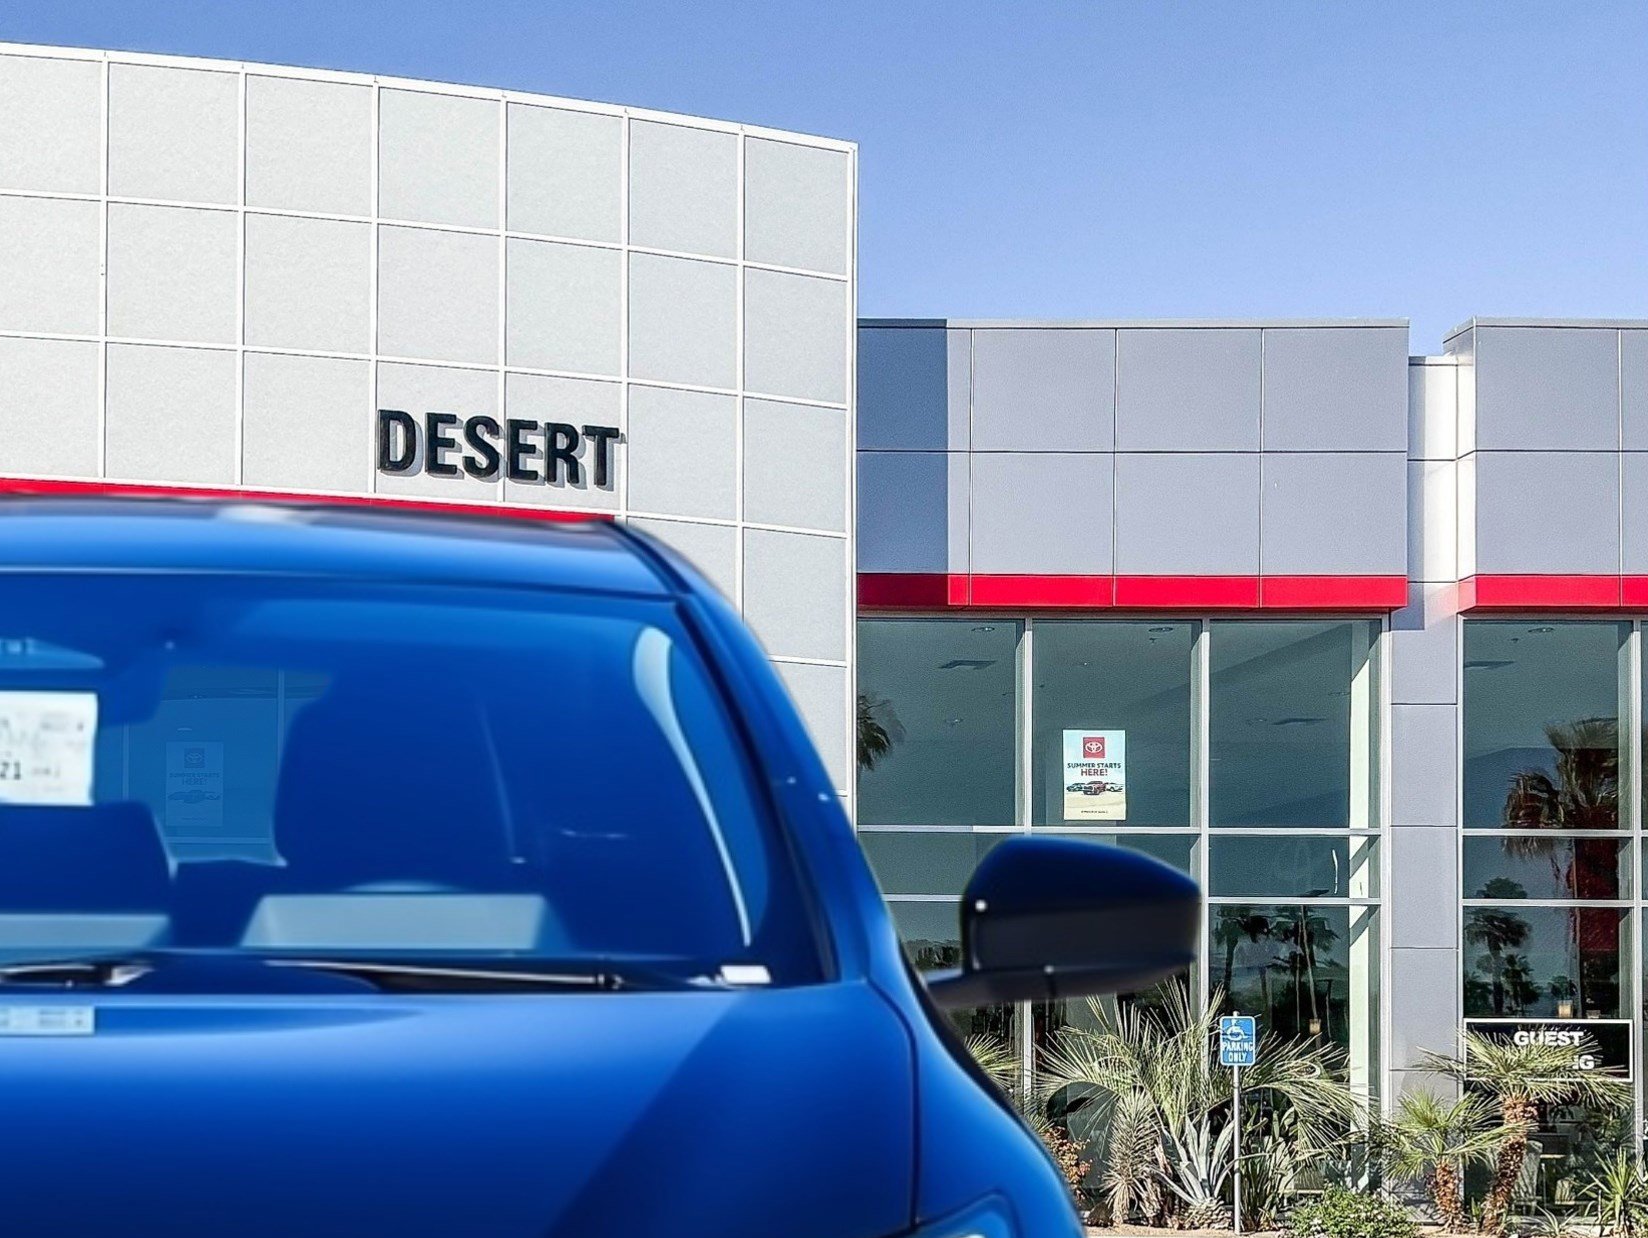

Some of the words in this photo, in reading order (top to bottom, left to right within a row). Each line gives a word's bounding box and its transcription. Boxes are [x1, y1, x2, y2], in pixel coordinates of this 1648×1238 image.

[377, 408, 620, 487] DESERT
[1513, 1030, 1584, 1047] GUEST
[1222, 1042, 1253, 1051] PARKING
[1228, 1052, 1248, 1062] ONLY
